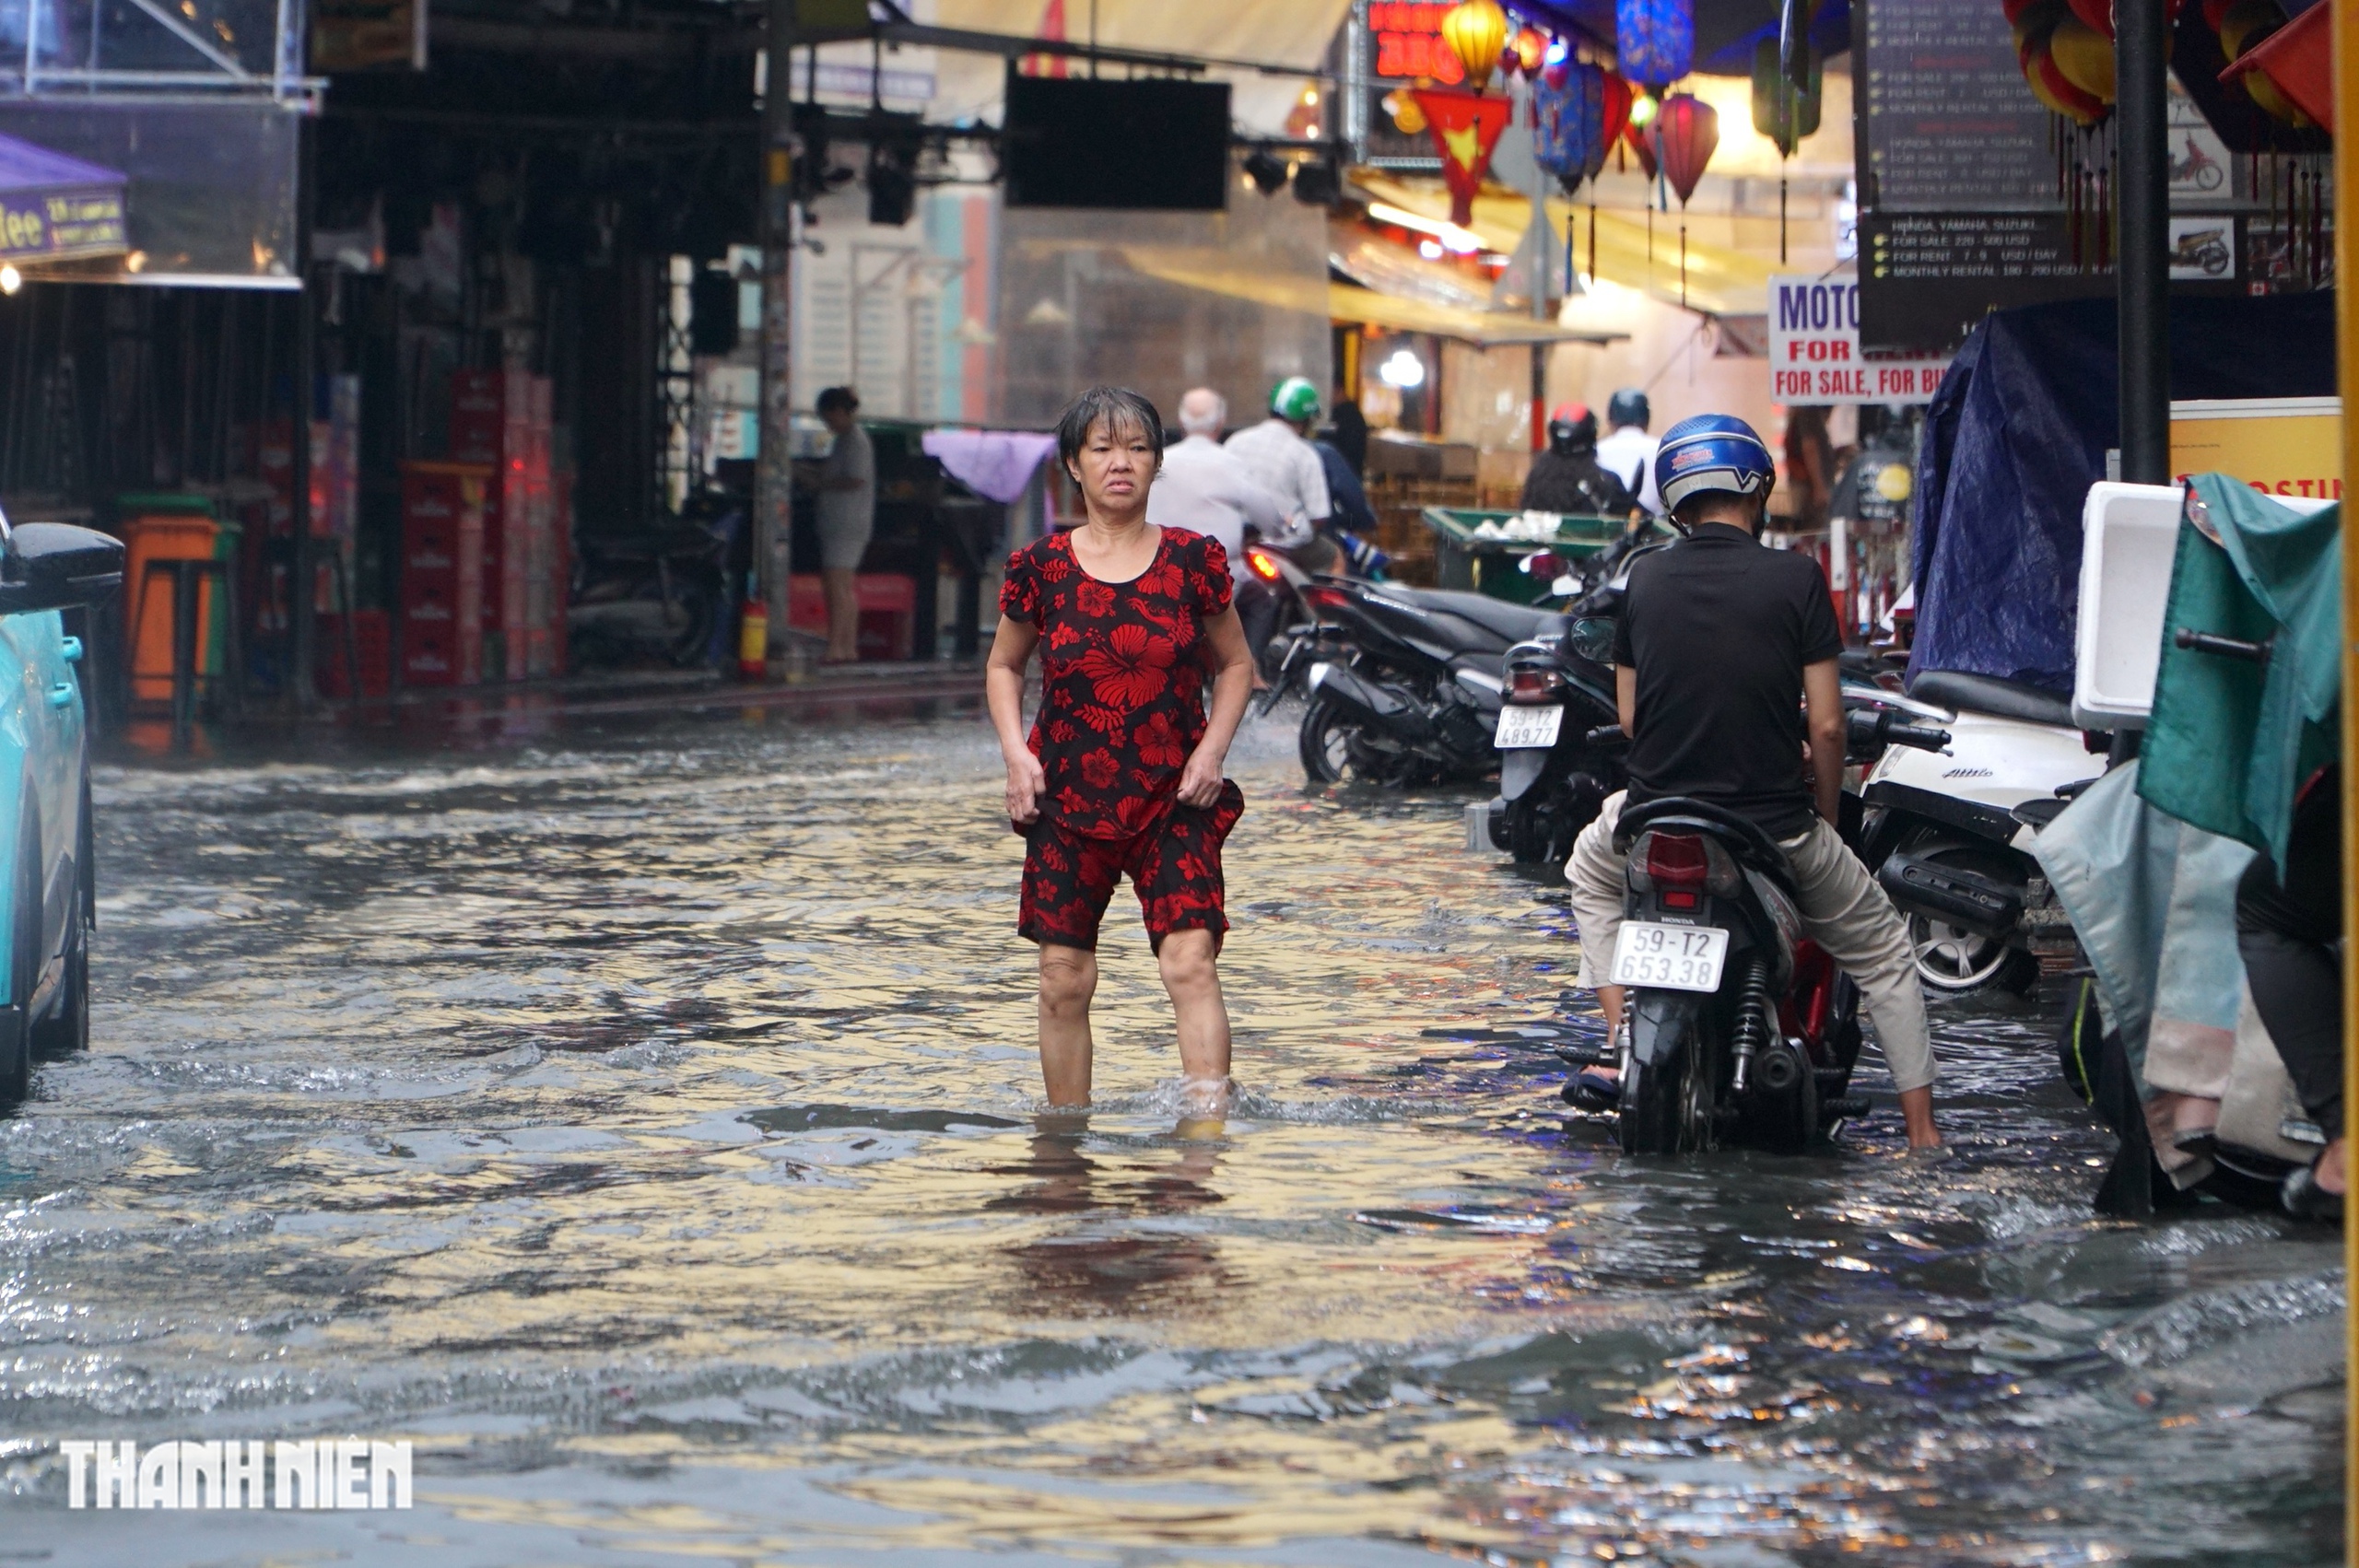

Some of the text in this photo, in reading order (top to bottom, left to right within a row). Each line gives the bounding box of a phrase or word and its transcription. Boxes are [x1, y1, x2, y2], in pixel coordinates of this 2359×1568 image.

[1893, 237, 1917, 248] FOR
[2005, 235, 2030, 246] USD
[1893, 252, 1917, 263] FOR
[2001, 250, 2026, 262] USD
[2034, 249, 2059, 261] DAY
[1893, 267, 1949, 277] MONTHLY
[2052, 264, 2078, 275] USD
[1789, 341, 1850, 362] FOR
[1776, 370, 1812, 397] FOR
[1818, 369, 1872, 398] SALE,
[1879, 369, 1914, 395] FOR
[1661, 916, 1696, 926] HONDA
[1634, 928, 1710, 957] 59-T2
[1620, 955, 1712, 986] 653.38
